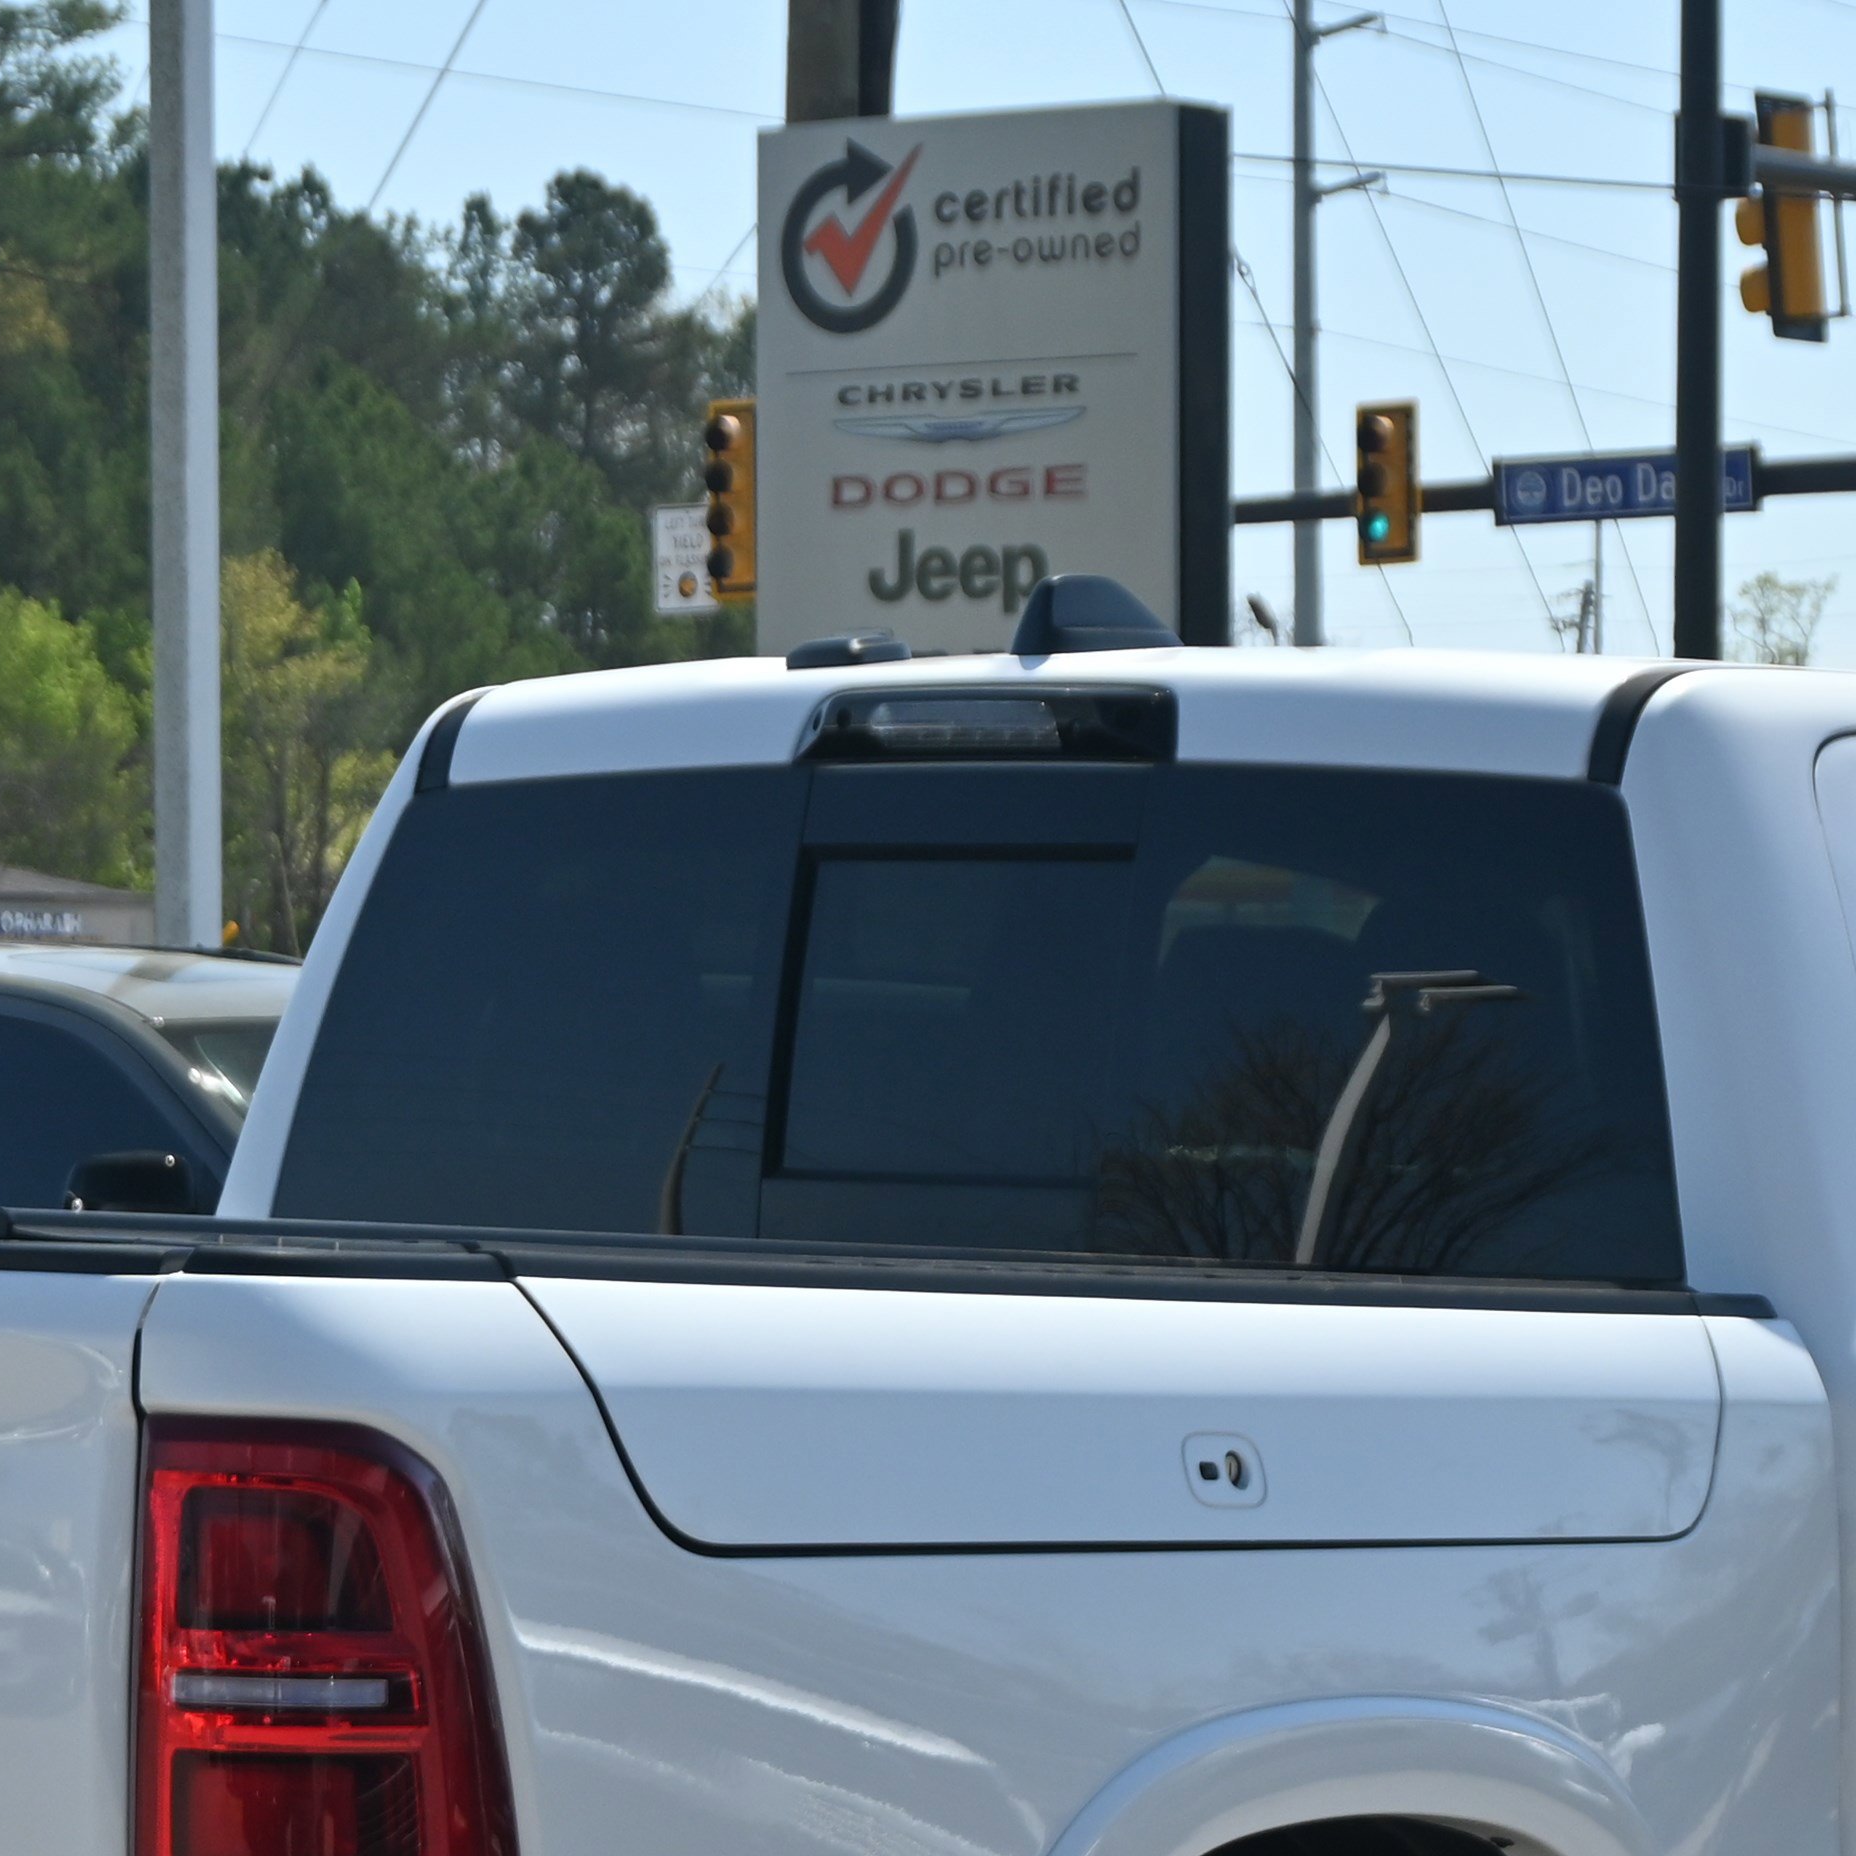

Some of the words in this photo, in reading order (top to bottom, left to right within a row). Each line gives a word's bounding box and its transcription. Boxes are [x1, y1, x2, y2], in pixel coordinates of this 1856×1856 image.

[933, 165, 1141, 225] certified
[933, 222, 1141, 276] pre-owned
[837, 372, 1081, 406] CHRYSLER
[830, 464, 1087, 510] DODGE
[1562, 467, 1623, 507] Deo
[1637, 462, 1676, 502] Da
[868, 528, 1049, 613] Jeep
